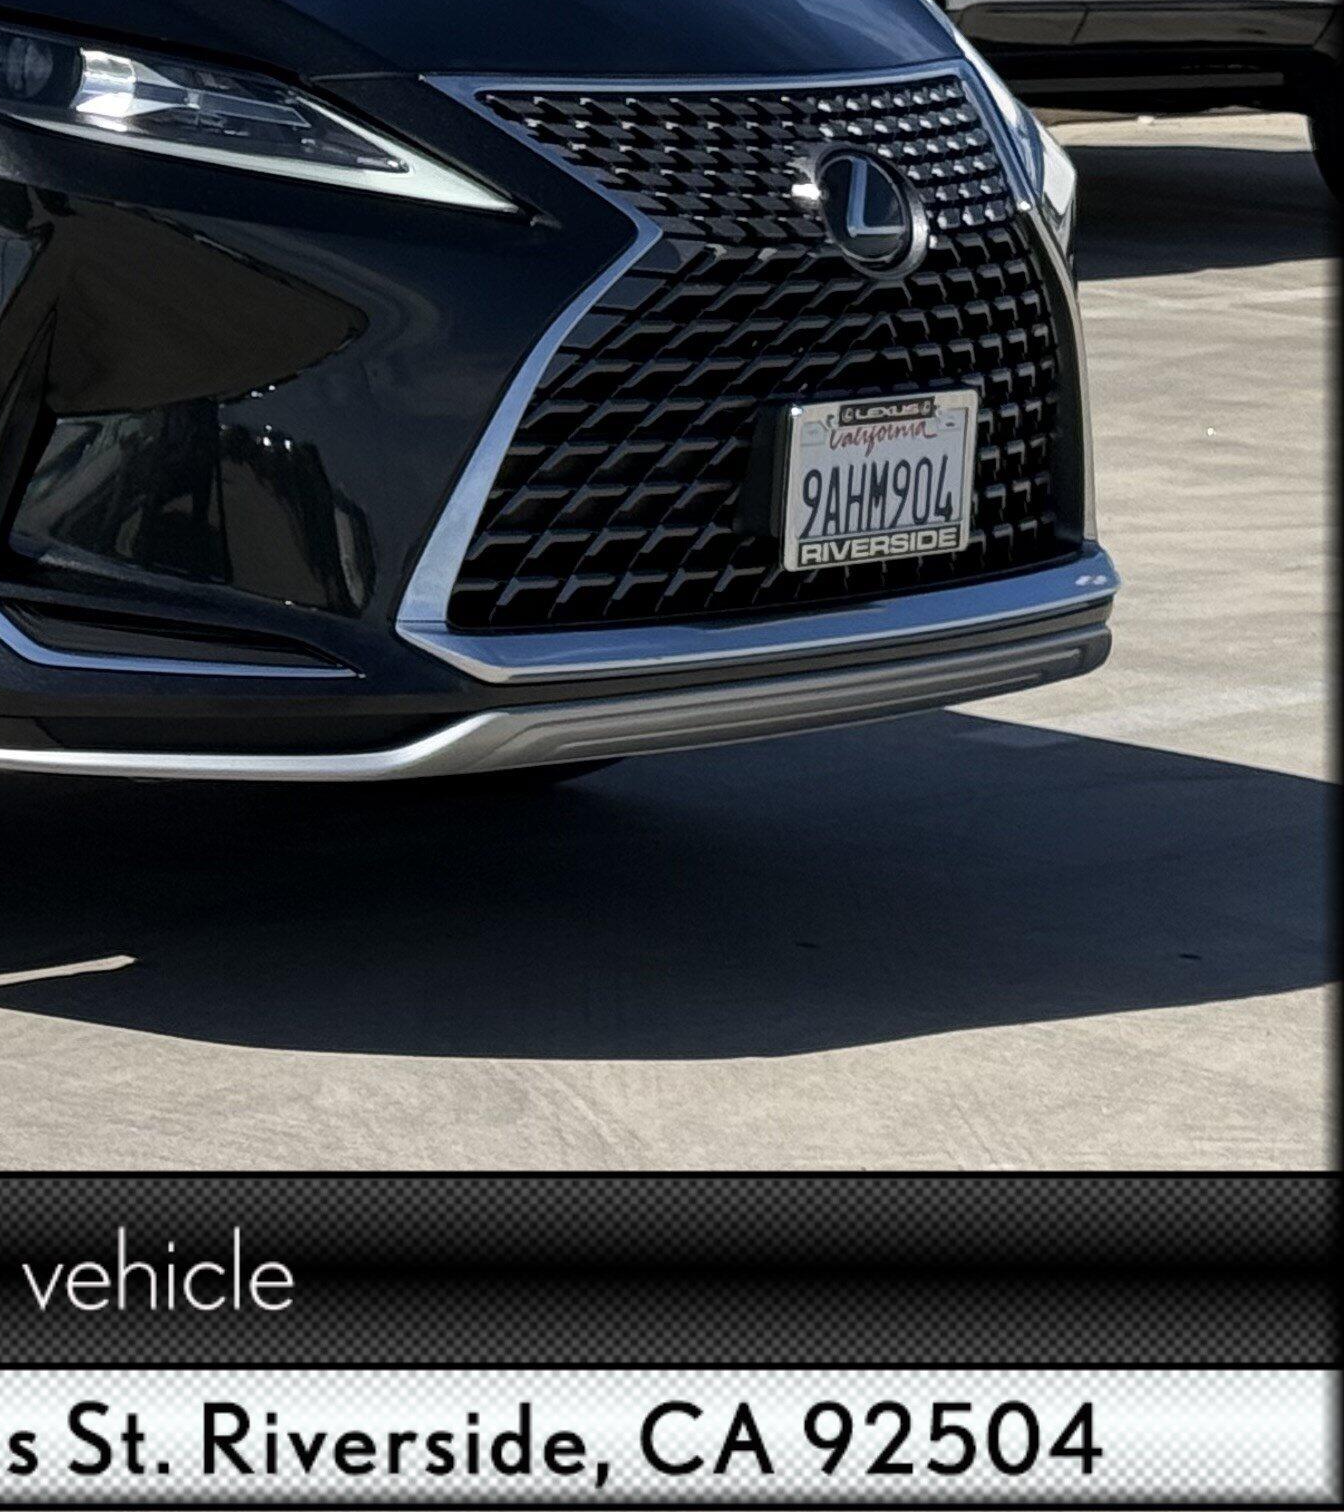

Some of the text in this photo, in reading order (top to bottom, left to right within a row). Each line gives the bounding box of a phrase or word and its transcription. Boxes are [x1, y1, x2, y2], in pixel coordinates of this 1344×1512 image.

[854, 402, 920, 419] LEXUS
[829, 420, 938, 457] California
[800, 454, 954, 538] 9AHM904
[801, 527, 958, 565] RIVERSIDE
